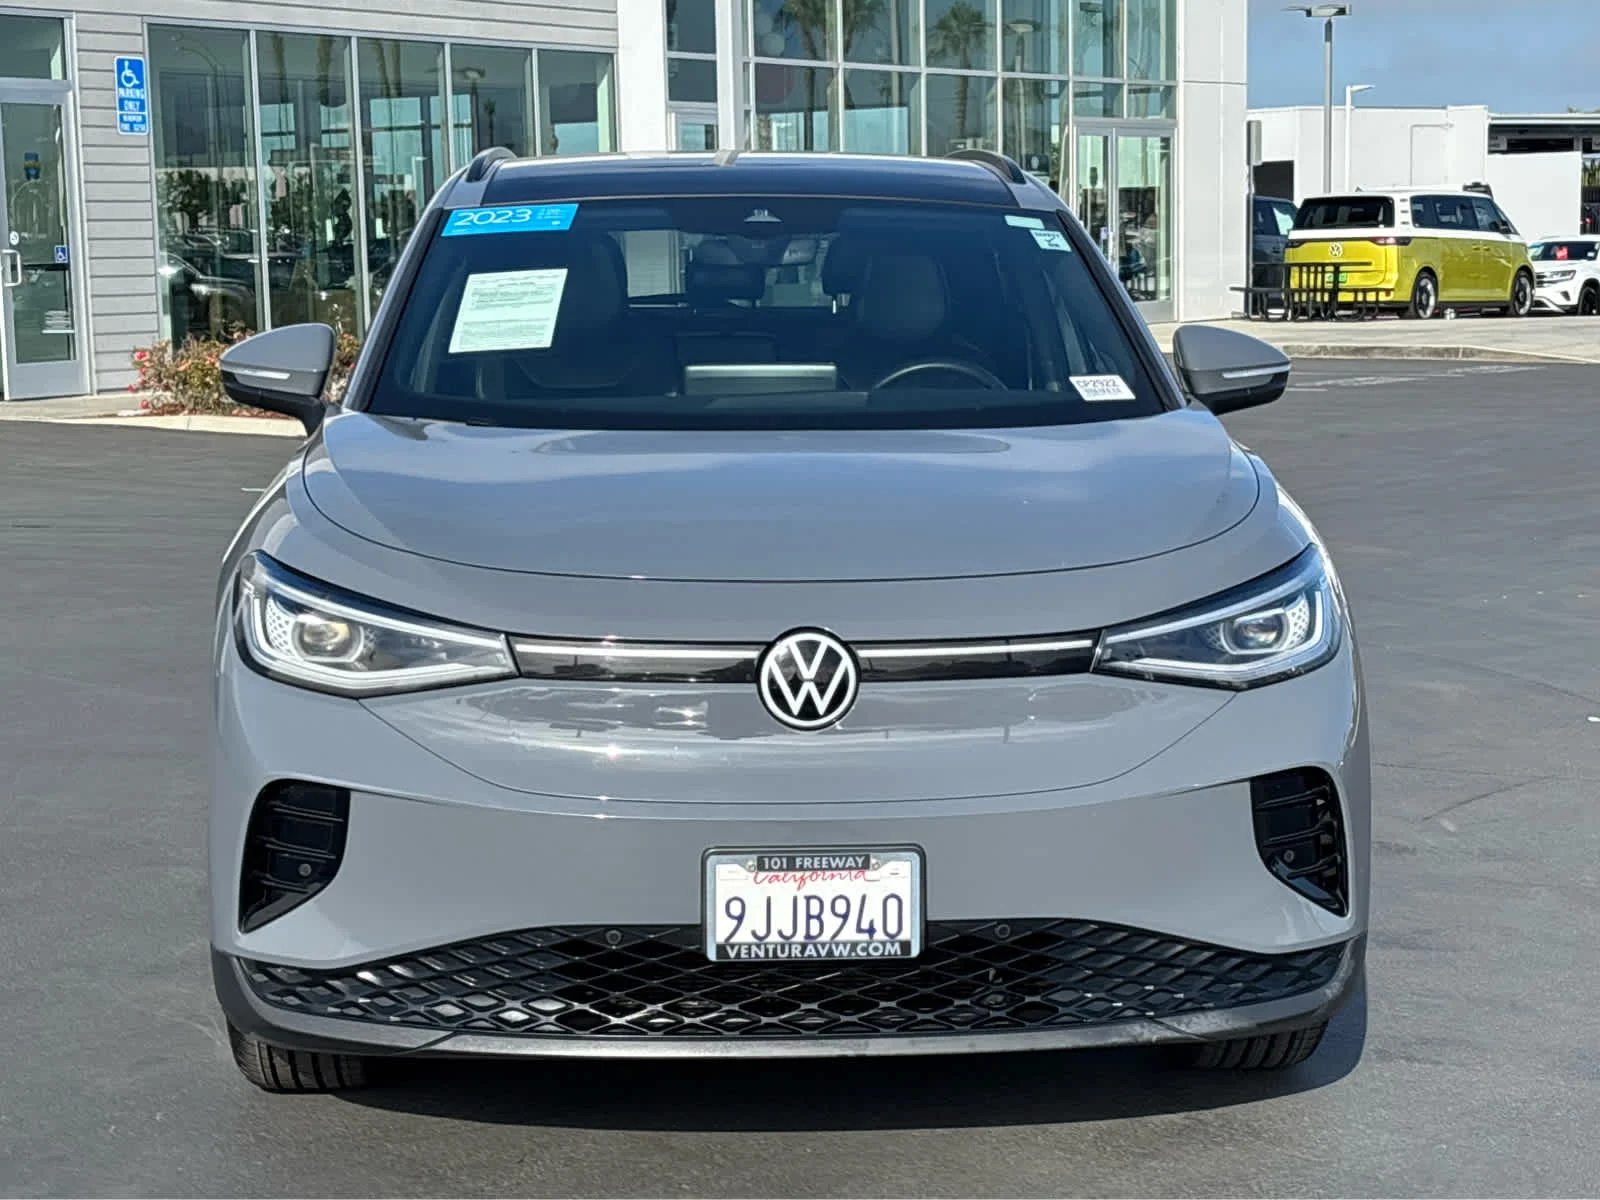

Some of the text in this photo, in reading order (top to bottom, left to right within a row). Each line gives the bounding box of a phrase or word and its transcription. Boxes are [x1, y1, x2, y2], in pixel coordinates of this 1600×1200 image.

[124, 100, 140, 112] ONLY
[453, 208, 533, 226] 2023
[763, 855, 866, 870] 101 FREEWAY
[753, 869, 880, 891] California
[724, 893, 904, 943] 9JJB940
[726, 942, 902, 959] VENTURAVW.COM
